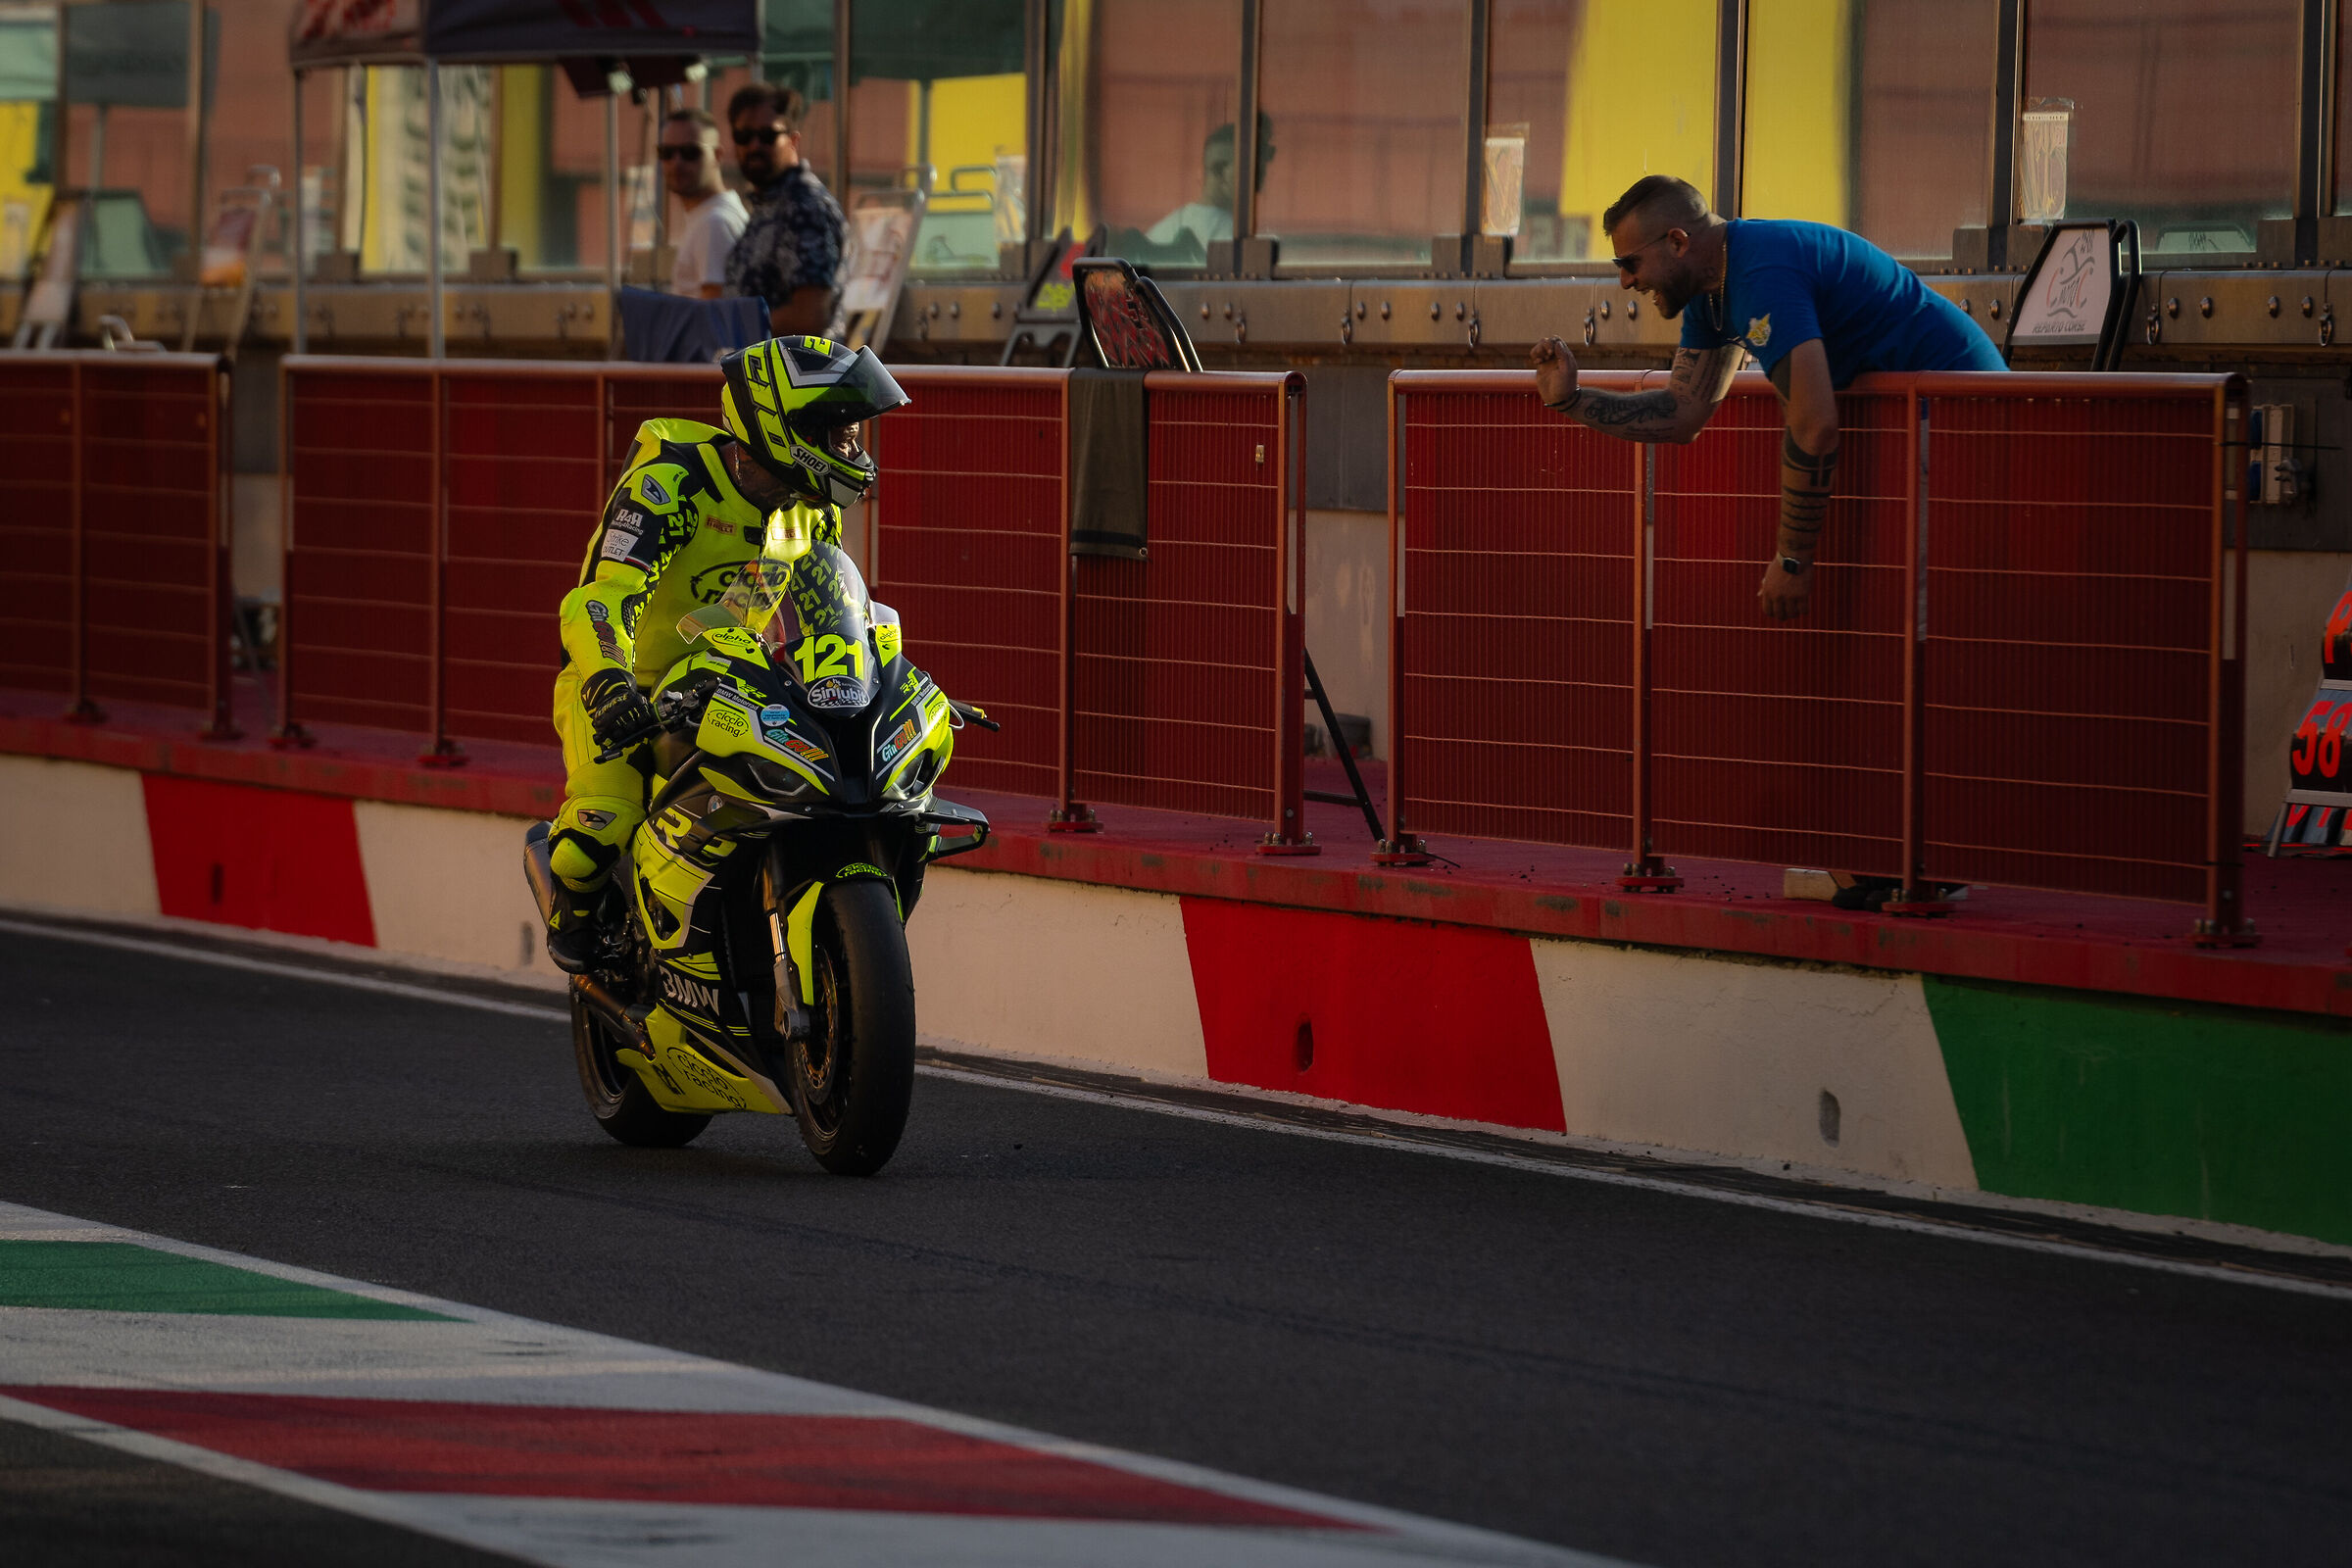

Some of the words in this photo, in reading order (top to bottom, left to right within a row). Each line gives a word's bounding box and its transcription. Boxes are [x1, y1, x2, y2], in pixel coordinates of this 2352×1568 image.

[794, 448, 827, 473] SHOEI
[615, 508, 644, 527] R4R
[713, 632, 752, 645] alpha
[794, 633, 864, 684] 121
[716, 688, 734, 699] BMW
[732, 693, 760, 710] Motorrad
[711, 718, 741, 738] racing
[716, 711, 744, 728] ciccio
[2292, 700, 2352, 778] 58
[659, 964, 720, 1017] BMW
[677, 1054, 729, 1091] ciccio
[685, 1070, 743, 1110] racing
